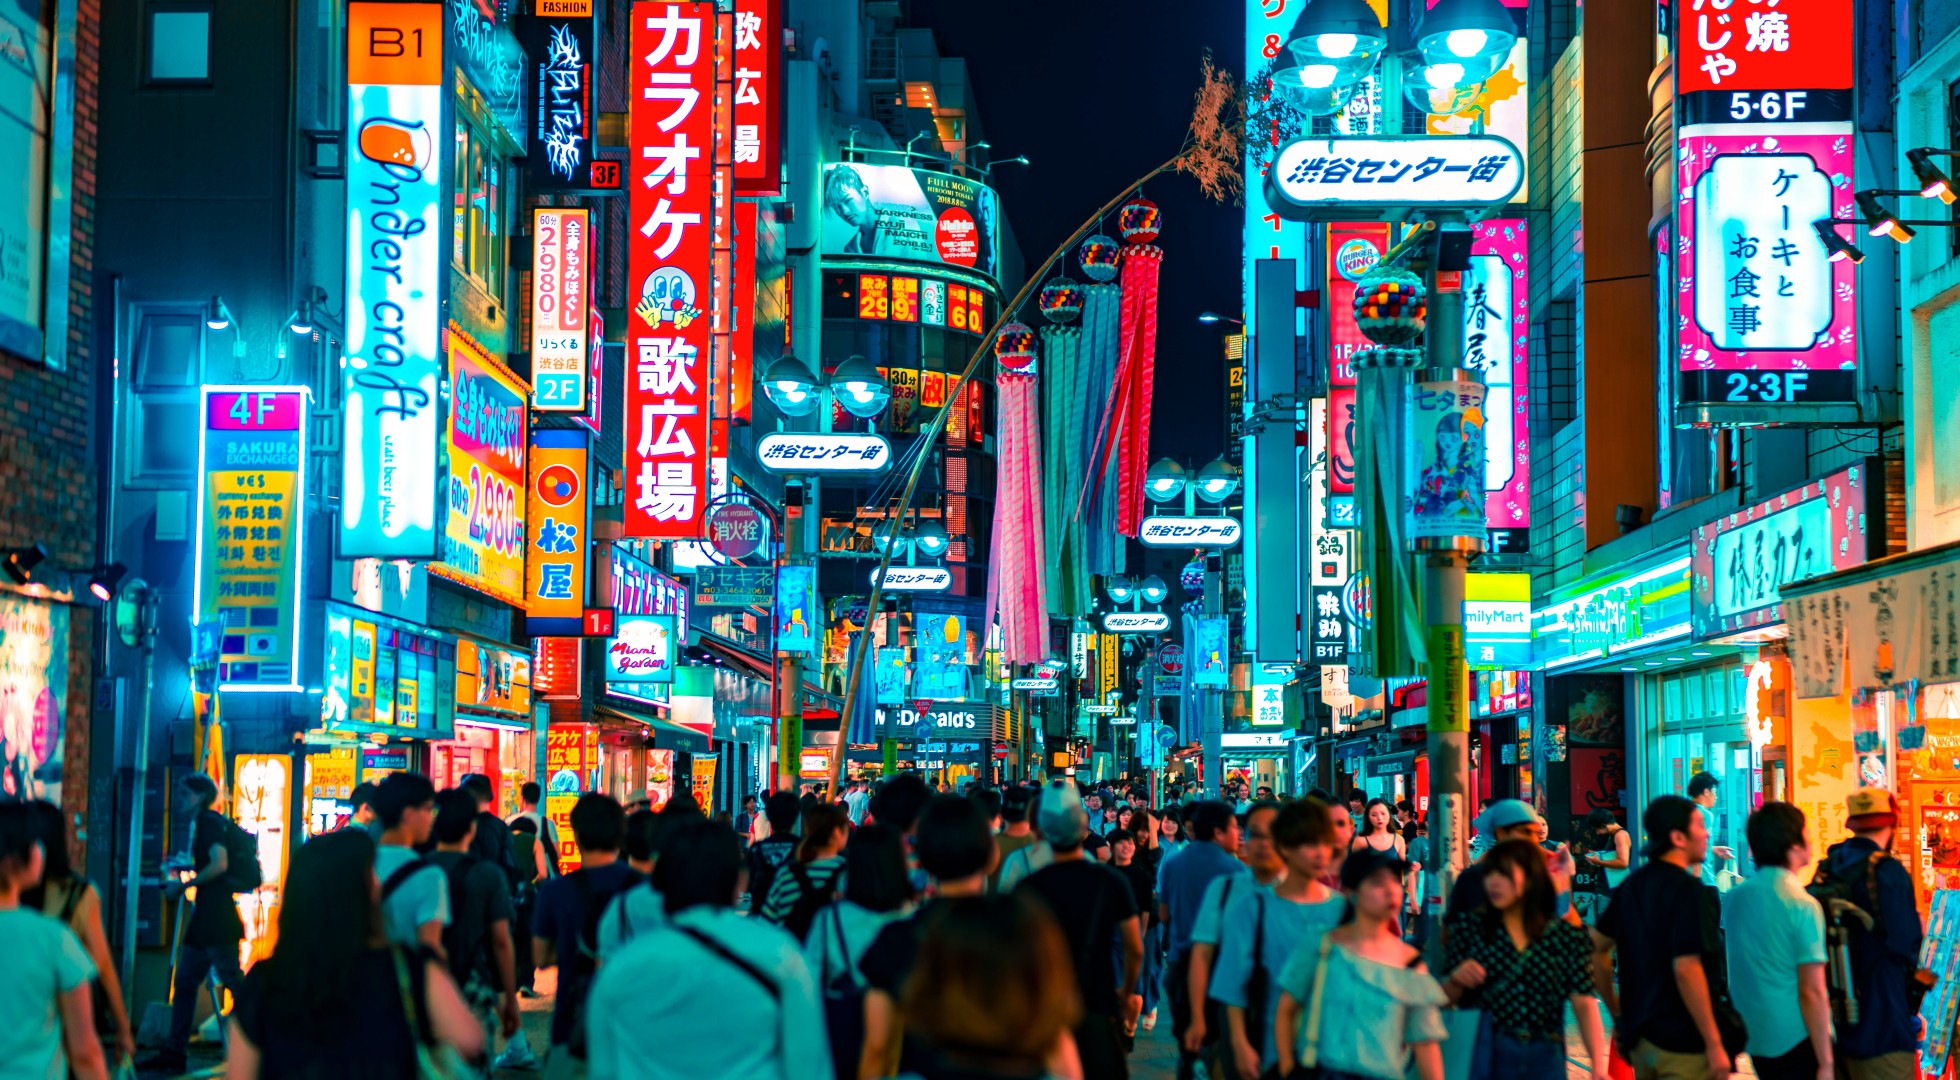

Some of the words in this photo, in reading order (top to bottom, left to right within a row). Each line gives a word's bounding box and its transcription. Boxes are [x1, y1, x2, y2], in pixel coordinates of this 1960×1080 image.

[543, 2, 587, 13] FASHION
[1744, 0, 1790, 52] 焼
[369, 28, 424, 58] B1
[1692, 0, 1737, 85] じゃ
[640, 5, 702, 260] カラオケ
[595, 165, 617, 184] 3F
[1287, 155, 1511, 184] 渋谷センター街
[927, 177, 950, 189] FULL
[874, 208, 933, 221] DARKNESS
[1771, 168, 1800, 298] ケーキと
[892, 239, 933, 249] 2018.8.1
[1343, 248, 1373, 262] BURGER
[564, 219, 581, 326] 全身もみほぐし
[1344, 256, 1374, 273] KING
[1729, 233, 1762, 336] お食事
[540, 338, 578, 350] りらくる
[354, 301, 428, 422] craft
[539, 357, 578, 370] 渋谷店
[892, 370, 916, 386] 30分
[543, 379, 575, 400] 2F
[892, 386, 916, 400] 飲み
[229, 392, 277, 425] 4F
[455, 367, 524, 469] 全身もみほぐし
[635, 335, 700, 522] 歌広場
[226, 441, 299, 454] SAKURA
[764, 445, 884, 460] 渋谷センター街
[226, 454, 288, 465] EXCHANGE
[451, 476, 469, 516] 60分
[714, 520, 759, 542] 消火栓
[1146, 525, 1237, 537] 渋谷センター街
[536, 517, 576, 599] 松屋
[218, 581, 276, 597] 外貨両替
[1107, 616, 1167, 627] 渋谷センター街
[609, 641, 657, 656] Miami
[1316, 645, 1343, 658] B1F
[1480, 646, 1495, 661] 酒
[617, 658, 670, 674] garden
[1074, 652, 1085, 678] 牛タン
[875, 709, 976, 729] MDald's
[547, 746, 581, 764] 広場
